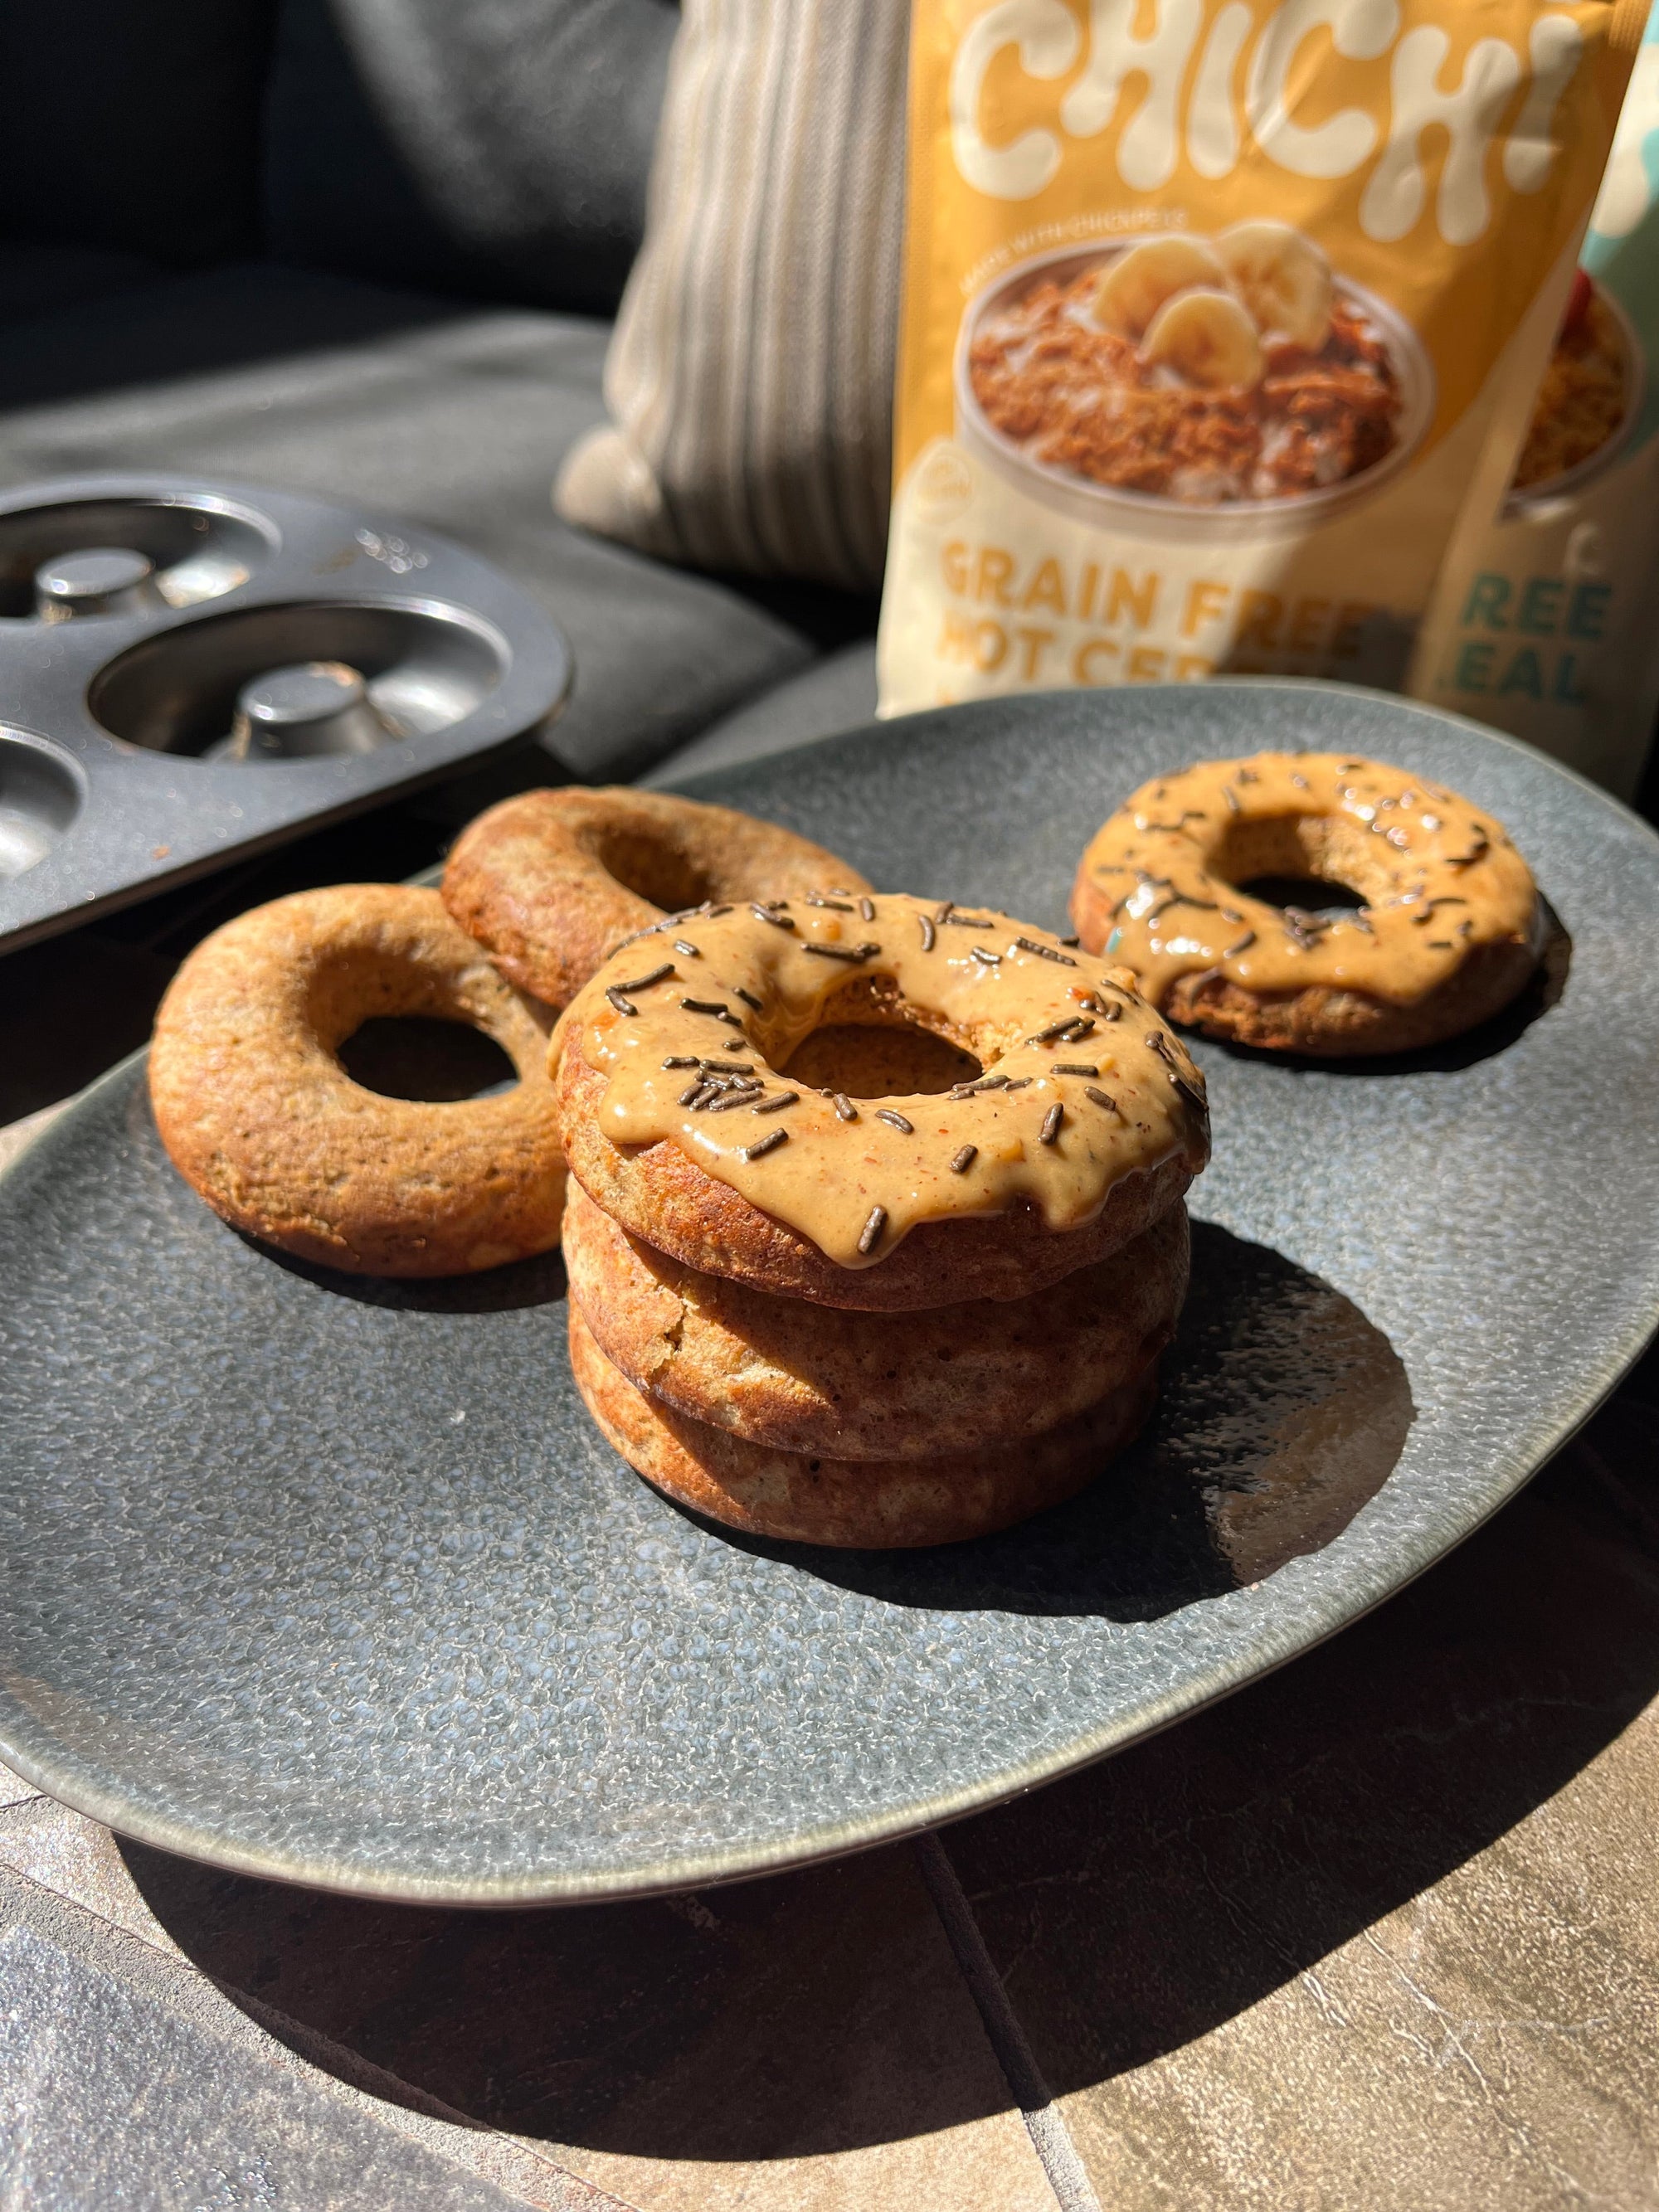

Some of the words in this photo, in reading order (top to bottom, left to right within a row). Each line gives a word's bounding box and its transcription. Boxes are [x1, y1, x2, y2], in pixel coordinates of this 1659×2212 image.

[949, 0, 1584, 245] CHICHI
[1009, 220, 1063, 255] WITH
[940, 541, 1160, 630] GRAIN
[1180, 581, 1377, 660] FREE
[1462, 570, 1612, 641] REE
[936, 608, 1055, 682] HOT
